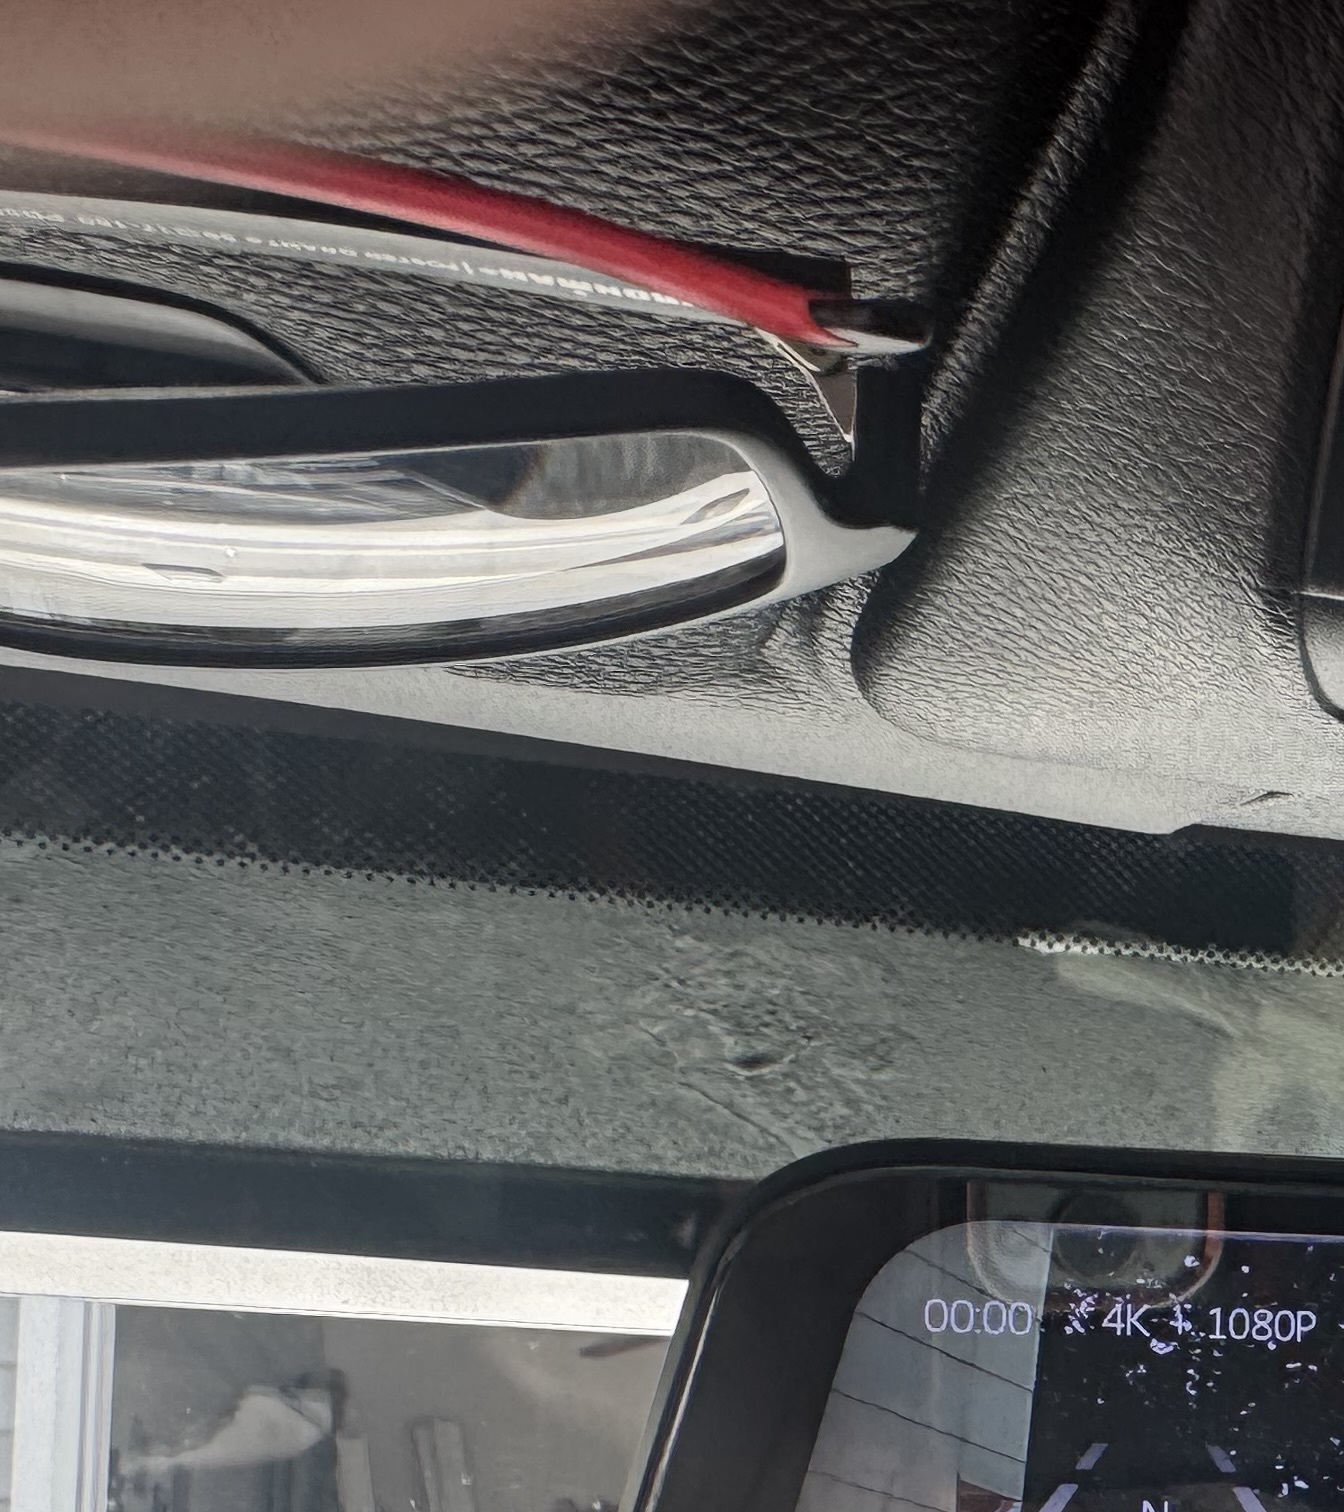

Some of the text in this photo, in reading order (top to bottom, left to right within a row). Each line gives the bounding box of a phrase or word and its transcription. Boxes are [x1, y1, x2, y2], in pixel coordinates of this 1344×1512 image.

[924, 1298, 1033, 1336] 00:00
[1101, 1303, 1151, 1337] 4K
[1208, 1307, 1317, 1343] 1080P
